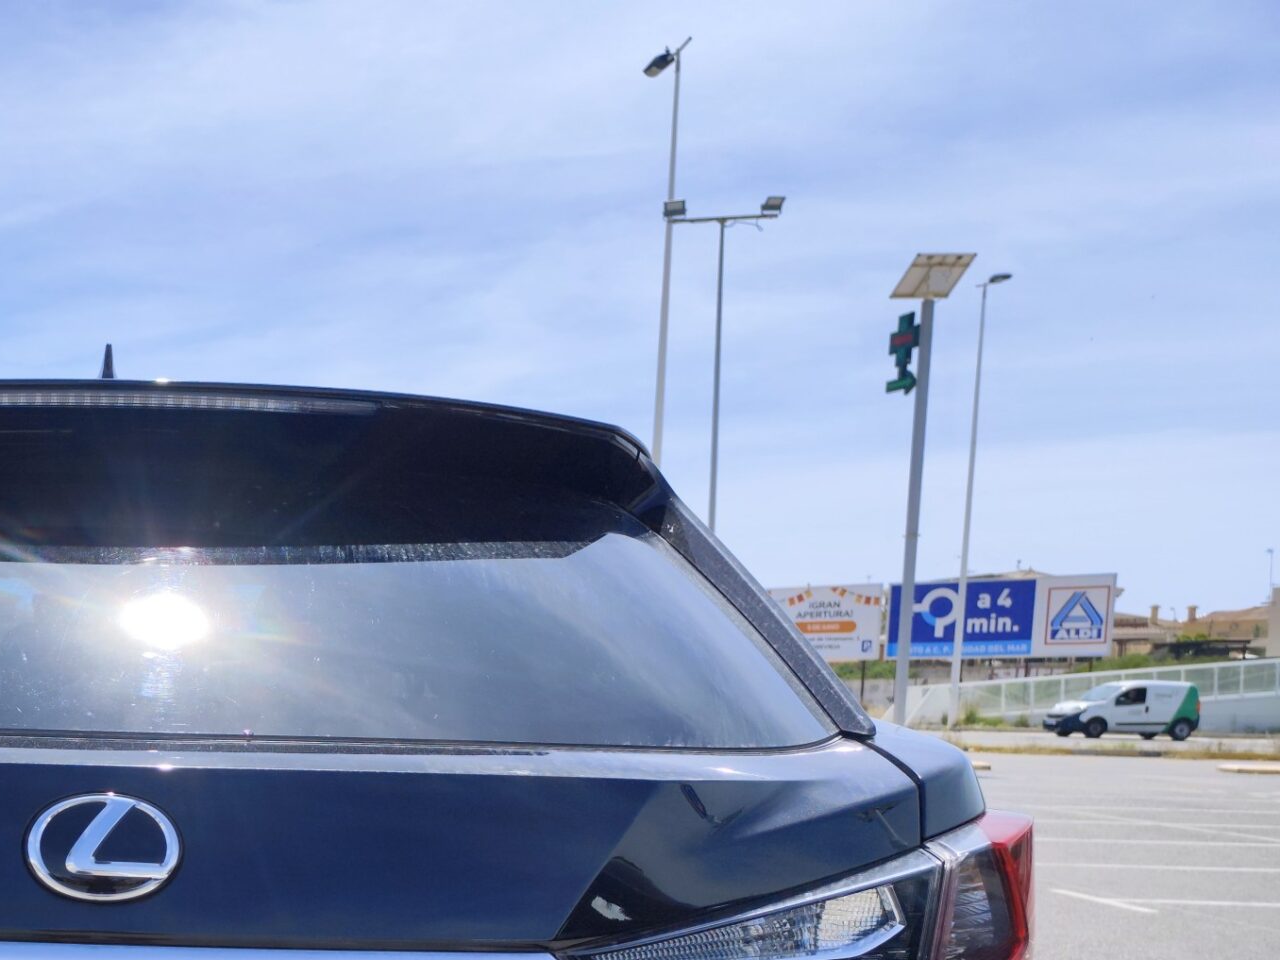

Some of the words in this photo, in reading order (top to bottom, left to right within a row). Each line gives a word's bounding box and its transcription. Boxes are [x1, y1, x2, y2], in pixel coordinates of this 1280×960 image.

[977, 593, 991, 609] a
[997, 588, 1012, 609] 4
[966, 613, 1019, 634] min.
[1053, 628, 1101, 640] ALDI
